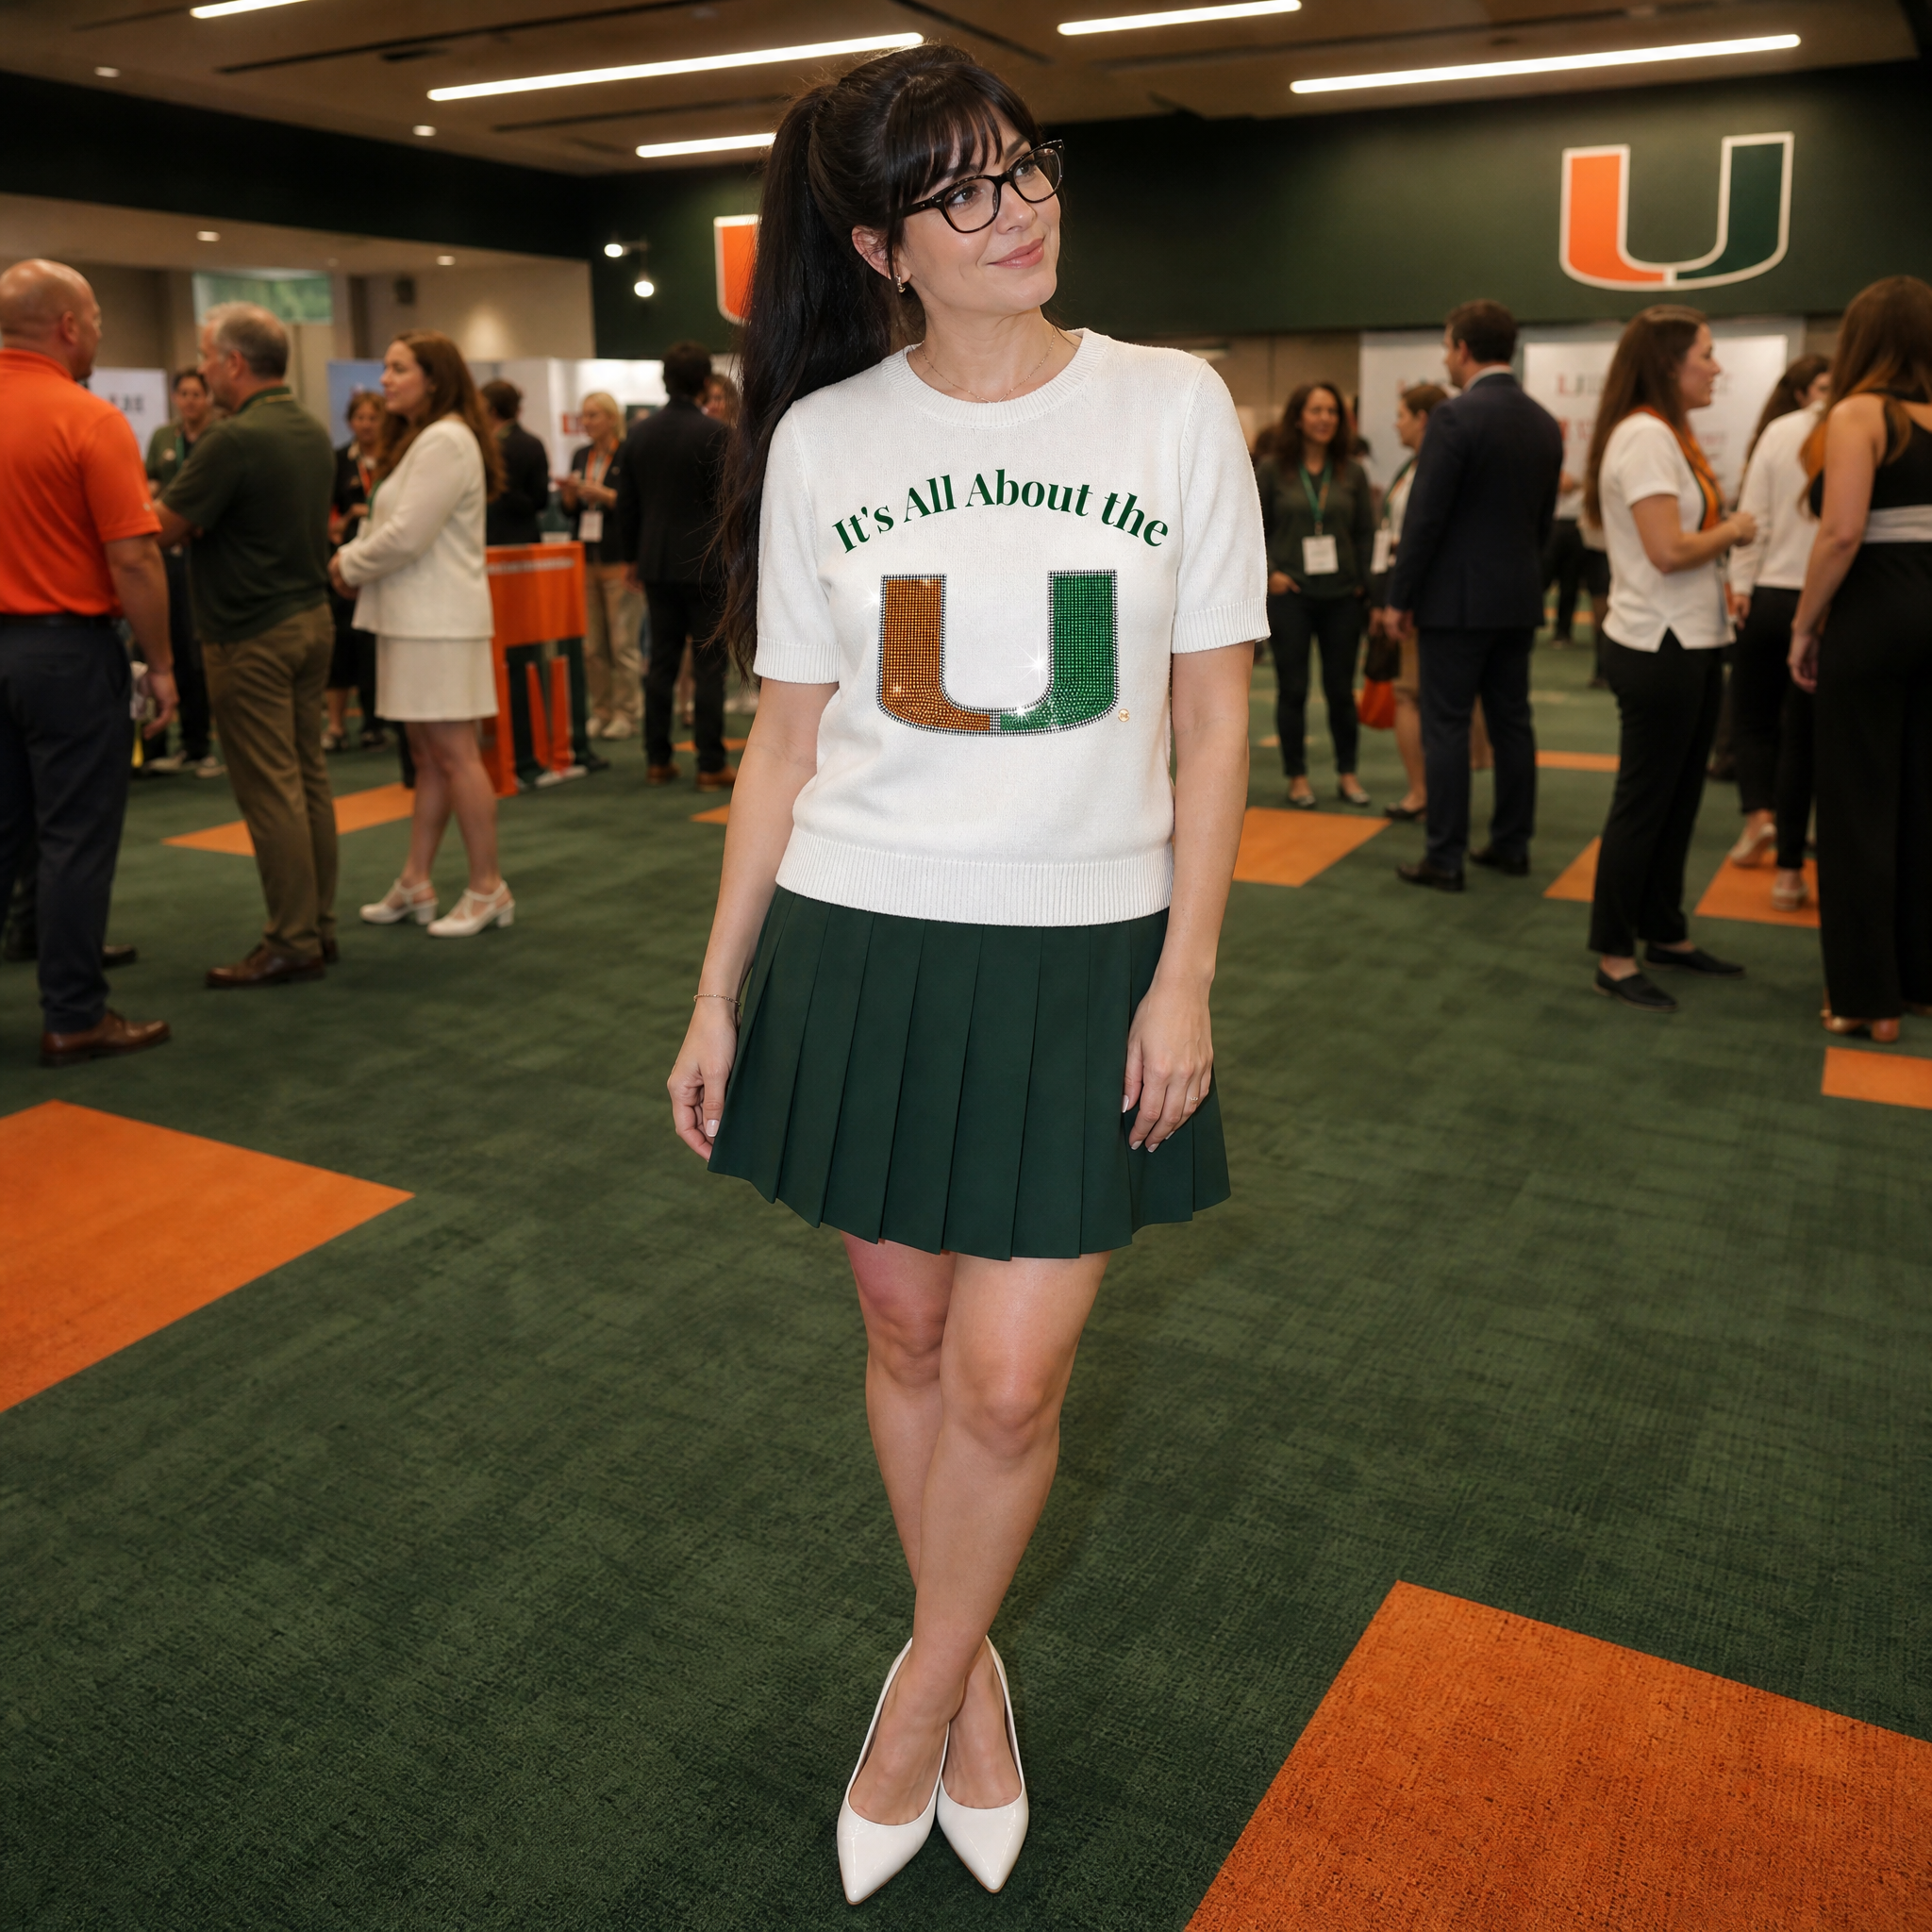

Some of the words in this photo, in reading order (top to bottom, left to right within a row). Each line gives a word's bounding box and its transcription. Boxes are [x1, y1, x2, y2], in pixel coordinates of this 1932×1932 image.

[1559, 131, 1794, 291] U
[831, 506, 894, 554] It's
[903, 474, 958, 524] All
[964, 469, 1093, 517] About
[1100, 491, 1169, 547] the
[876, 569, 1120, 737] U
